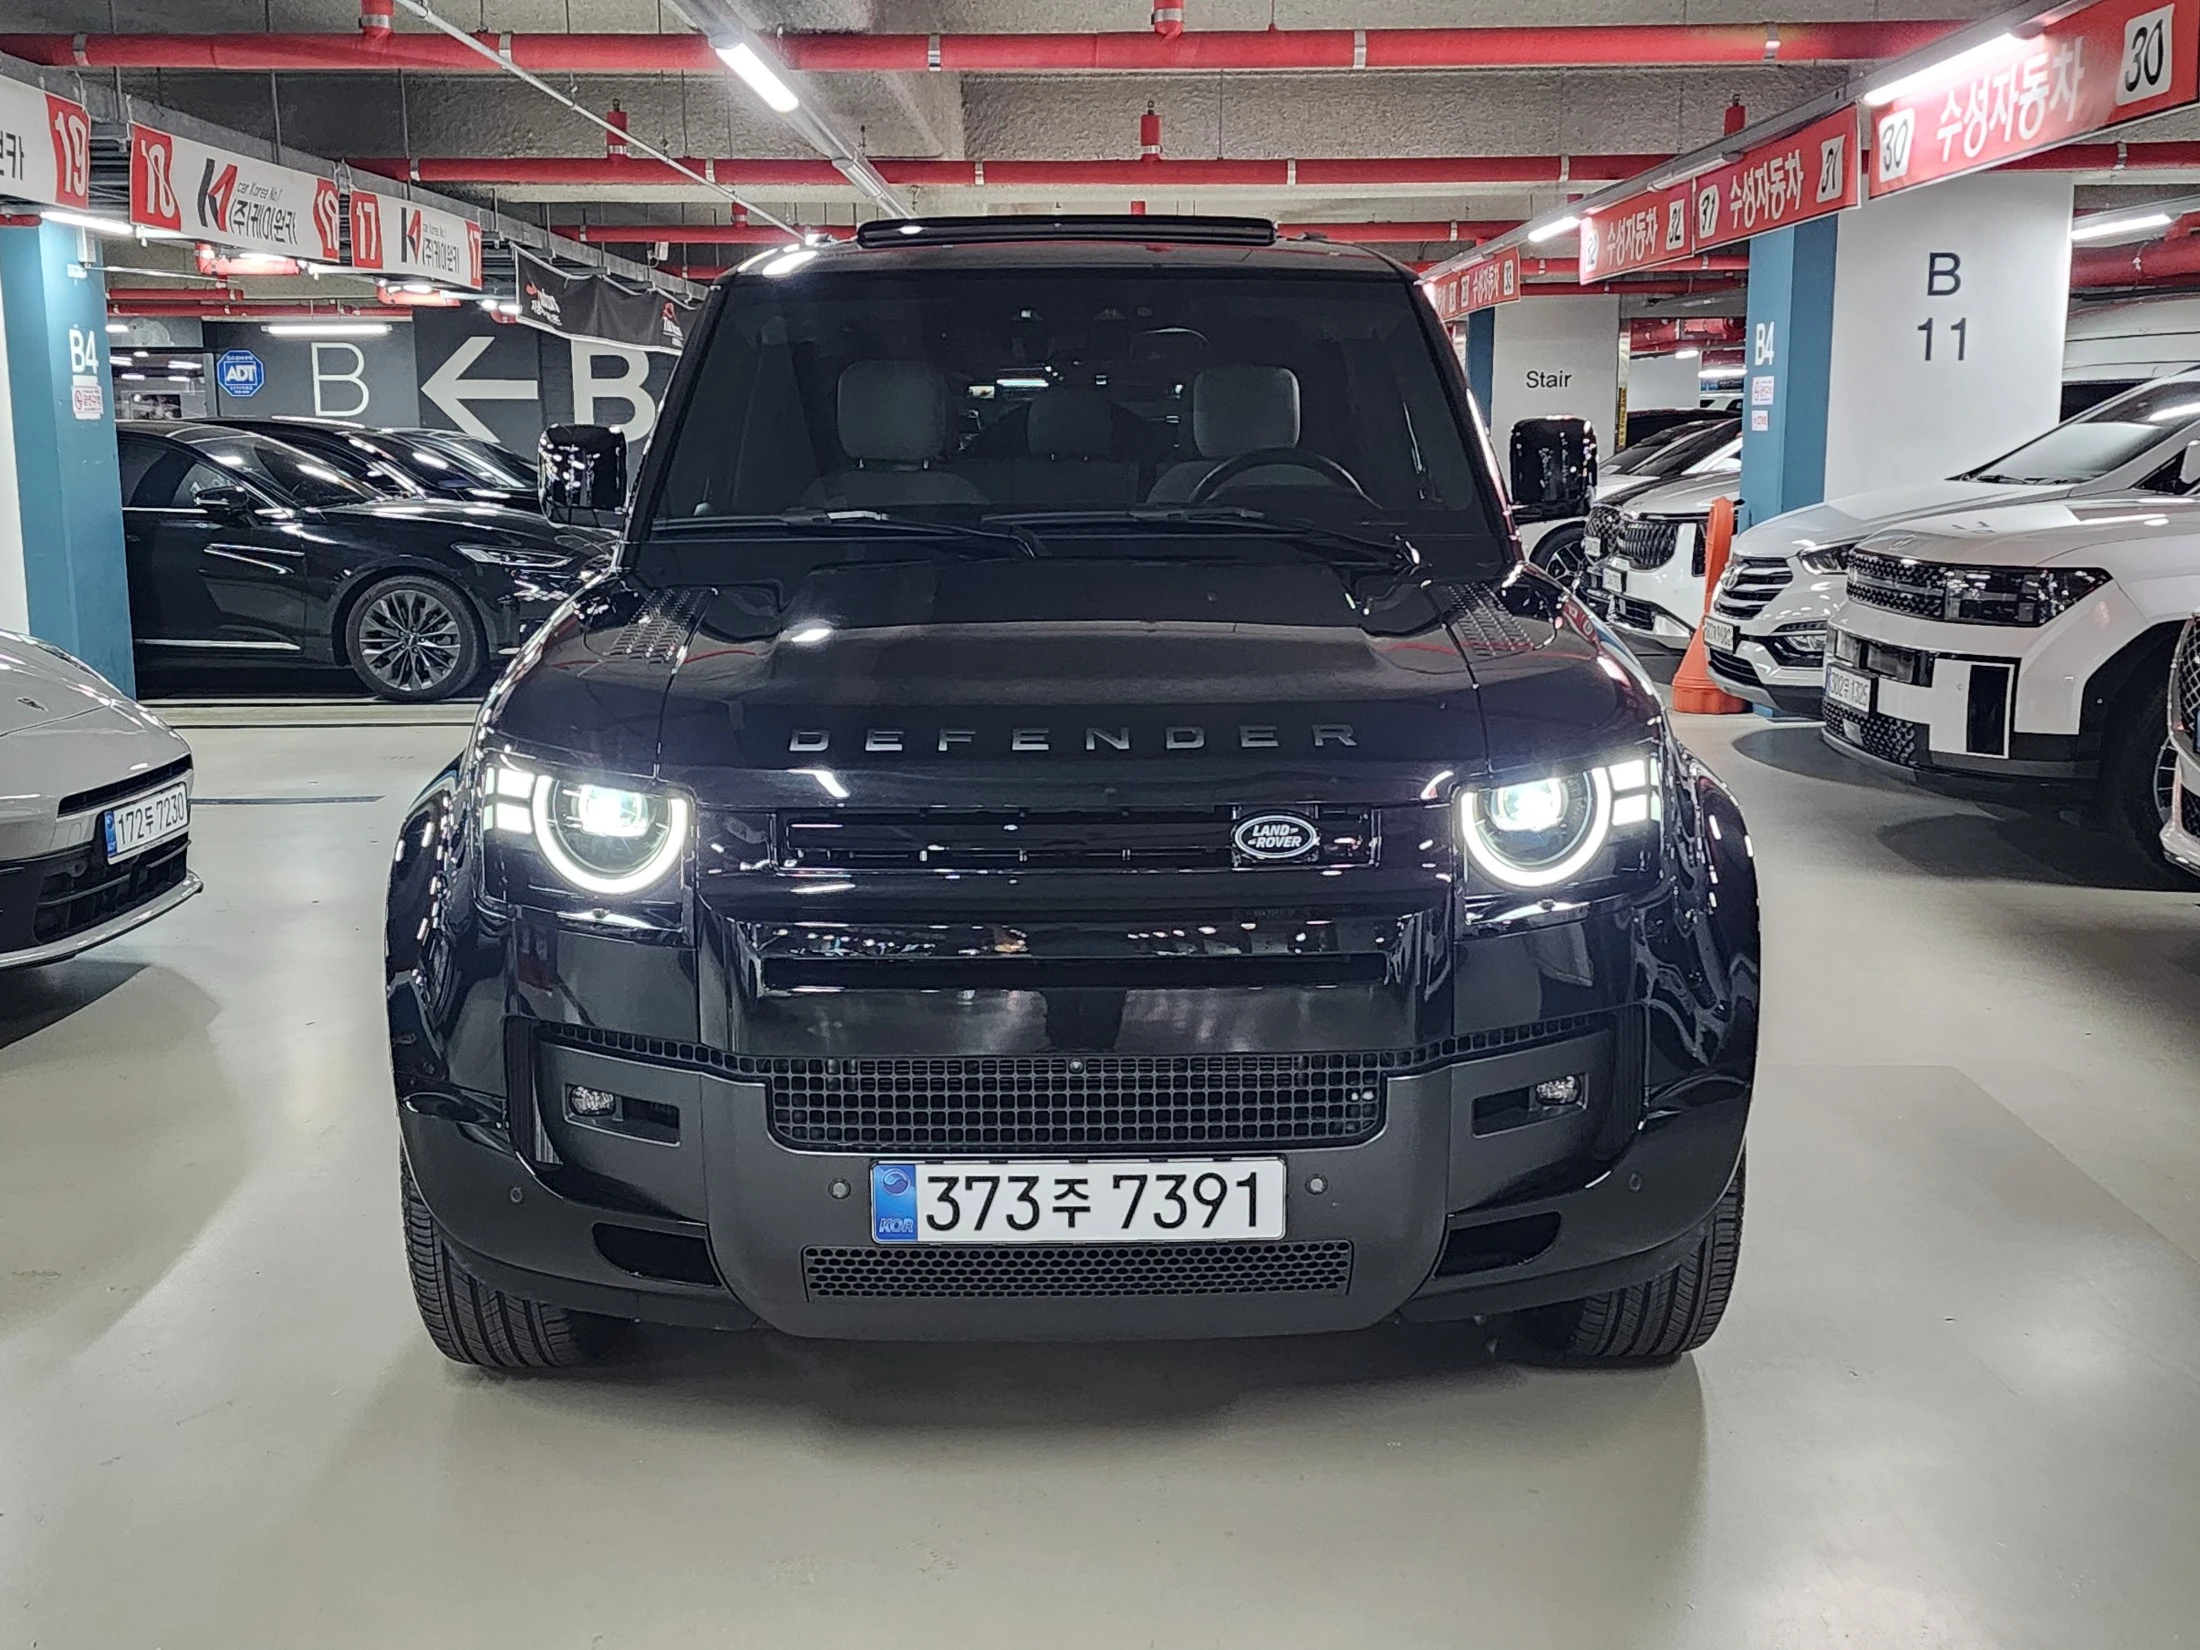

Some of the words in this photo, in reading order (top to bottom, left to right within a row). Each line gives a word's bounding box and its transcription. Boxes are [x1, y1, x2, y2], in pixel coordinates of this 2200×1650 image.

[2124, 18, 2164, 93] 30
[1937, 36, 2085, 163] 수성자동차
[55, 111, 87, 196] 19
[1821, 147, 1839, 194] 31
[1882, 118, 1908, 173] 30
[141, 140, 175, 218] 18
[1729, 149, 1805, 229] 수성자동차
[229, 198, 298, 245] (주)케이원카
[356, 201, 377, 260] 17
[1607, 205, 1659, 266] 수성자동차
[1668, 209, 1682, 243] 32
[1700, 188, 1716, 232] 31
[469, 228, 482, 279] 17
[1927, 252, 1961, 296] B
[69, 328, 99, 375] B4
[1755, 321, 1774, 366] B4
[1917, 317, 1967, 361] 11
[226, 364, 256, 381] ADT
[311, 342, 370, 417] B
[571, 340, 657, 444] B
[1526, 371, 1572, 389] Stair
[788, 722, 1358, 752] DEFENDER
[118, 806, 154, 845] 172두
[156, 791, 185, 832] 7230
[879, 1218, 915, 1234] KOR
[925, 1174, 1091, 1231] 373주
[1112, 1171, 1258, 1229] 7391
